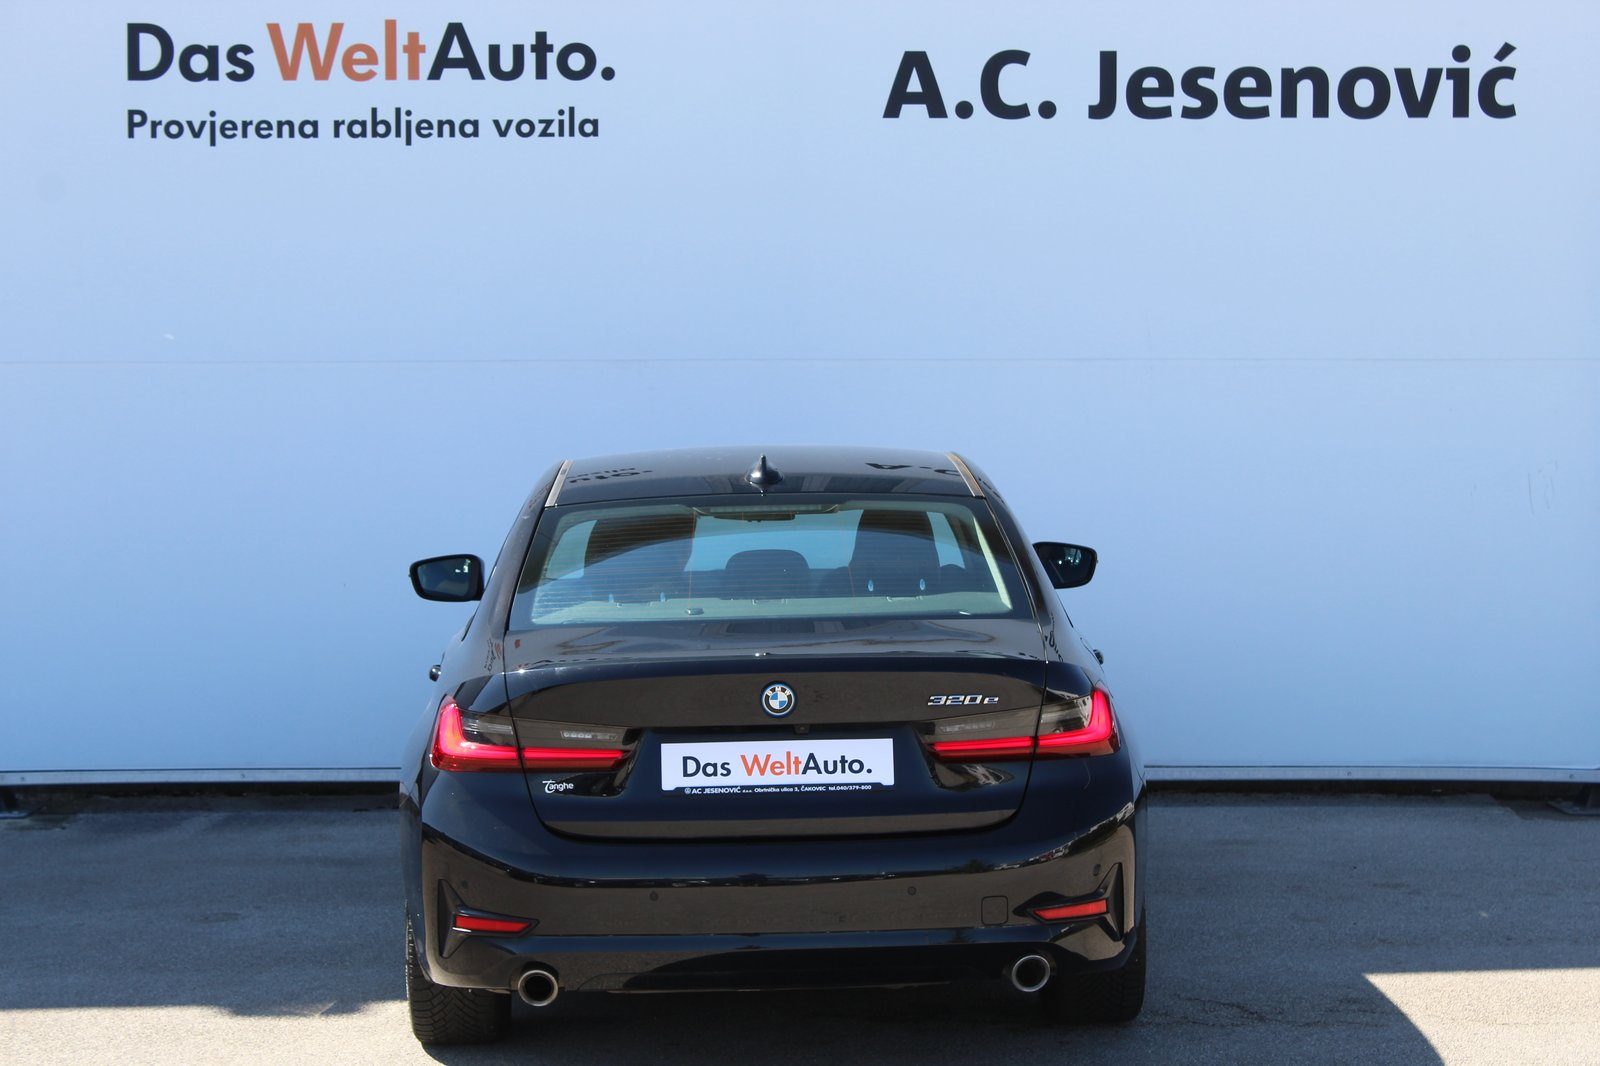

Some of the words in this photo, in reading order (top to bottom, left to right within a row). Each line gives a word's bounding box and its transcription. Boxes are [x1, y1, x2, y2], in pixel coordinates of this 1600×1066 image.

[127, 22, 254, 82] Das
[266, 19, 616, 82] WeltAuto.
[883, 50, 1056, 119] A.C.
[1088, 42, 1517, 119] Jesenović
[128, 109, 318, 147] Provjerena
[334, 107, 479, 147] rabljena
[492, 106, 599, 139] vozila
[682, 755, 732, 778] Das
[740, 751, 873, 777] WeltAuto.
[542, 779, 574, 794] Tanghe
[703, 786, 741, 794] JESENOVIĆ
